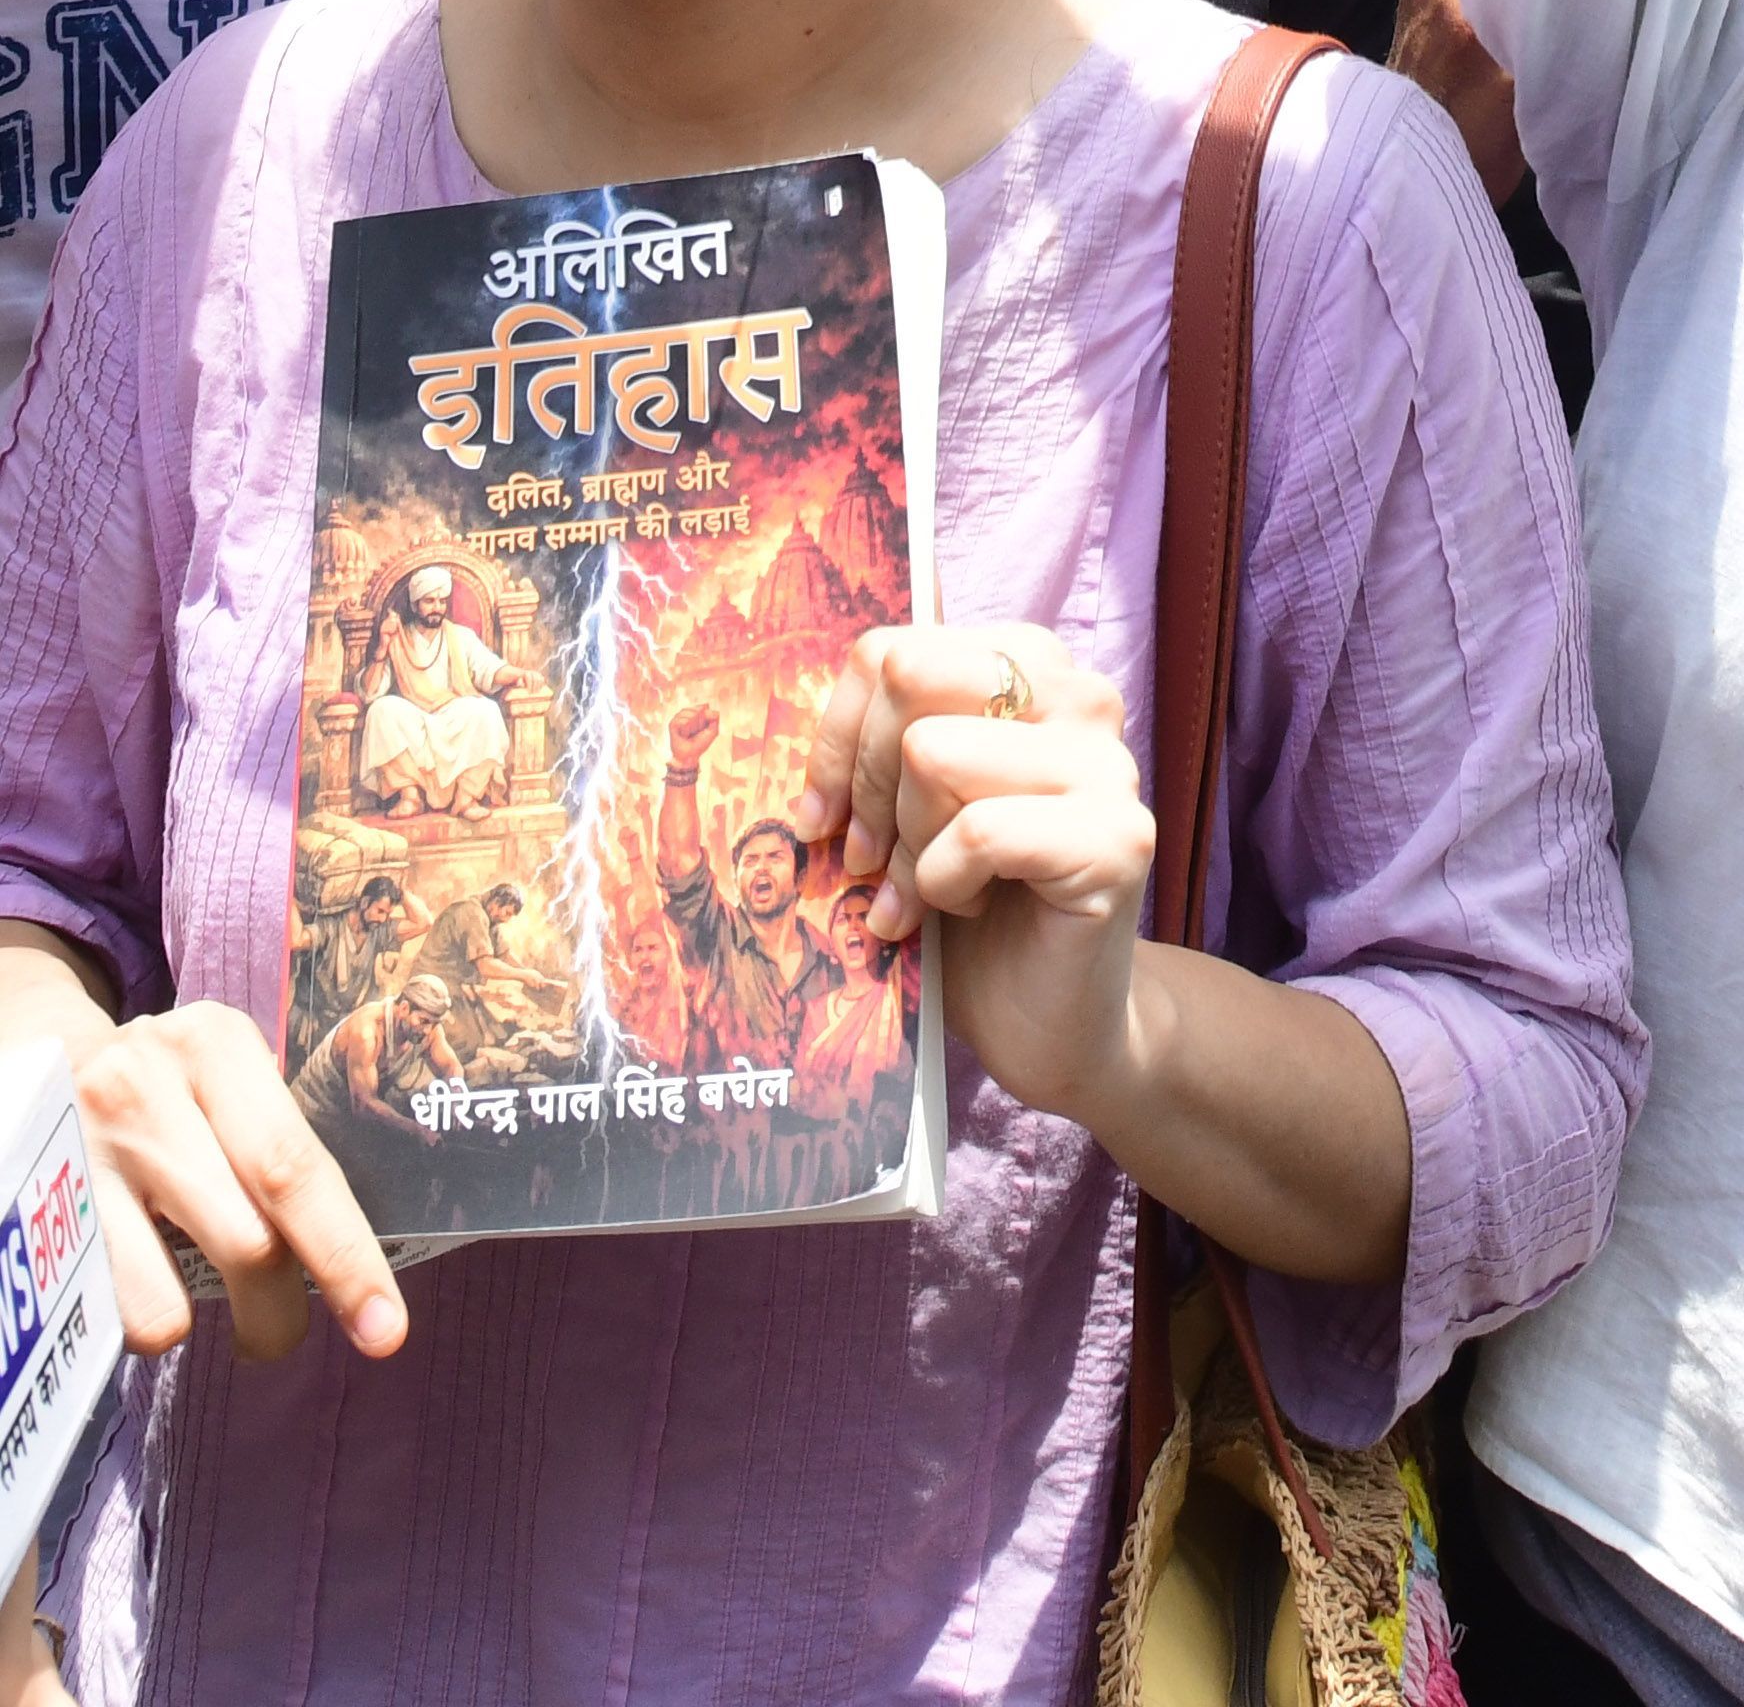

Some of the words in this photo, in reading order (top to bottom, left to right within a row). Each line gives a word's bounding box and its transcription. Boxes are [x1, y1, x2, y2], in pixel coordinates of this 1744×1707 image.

[482, 208, 734, 300] अलिखित
[407, 302, 812, 471] इतिहास
[485, 470, 573, 518] दलित,
[674, 450, 731, 492] और
[466, 526, 538, 557] मानव
[543, 516, 629, 551] सम्मान
[635, 503, 673, 540] की
[679, 494, 752, 539] लड़ाई
[410, 1078, 520, 1135] धीरेन्द्र
[529, 1082, 602, 1126] पाल
[612, 1061, 687, 1125] सिंह
[697, 1055, 793, 1111] बघेल
